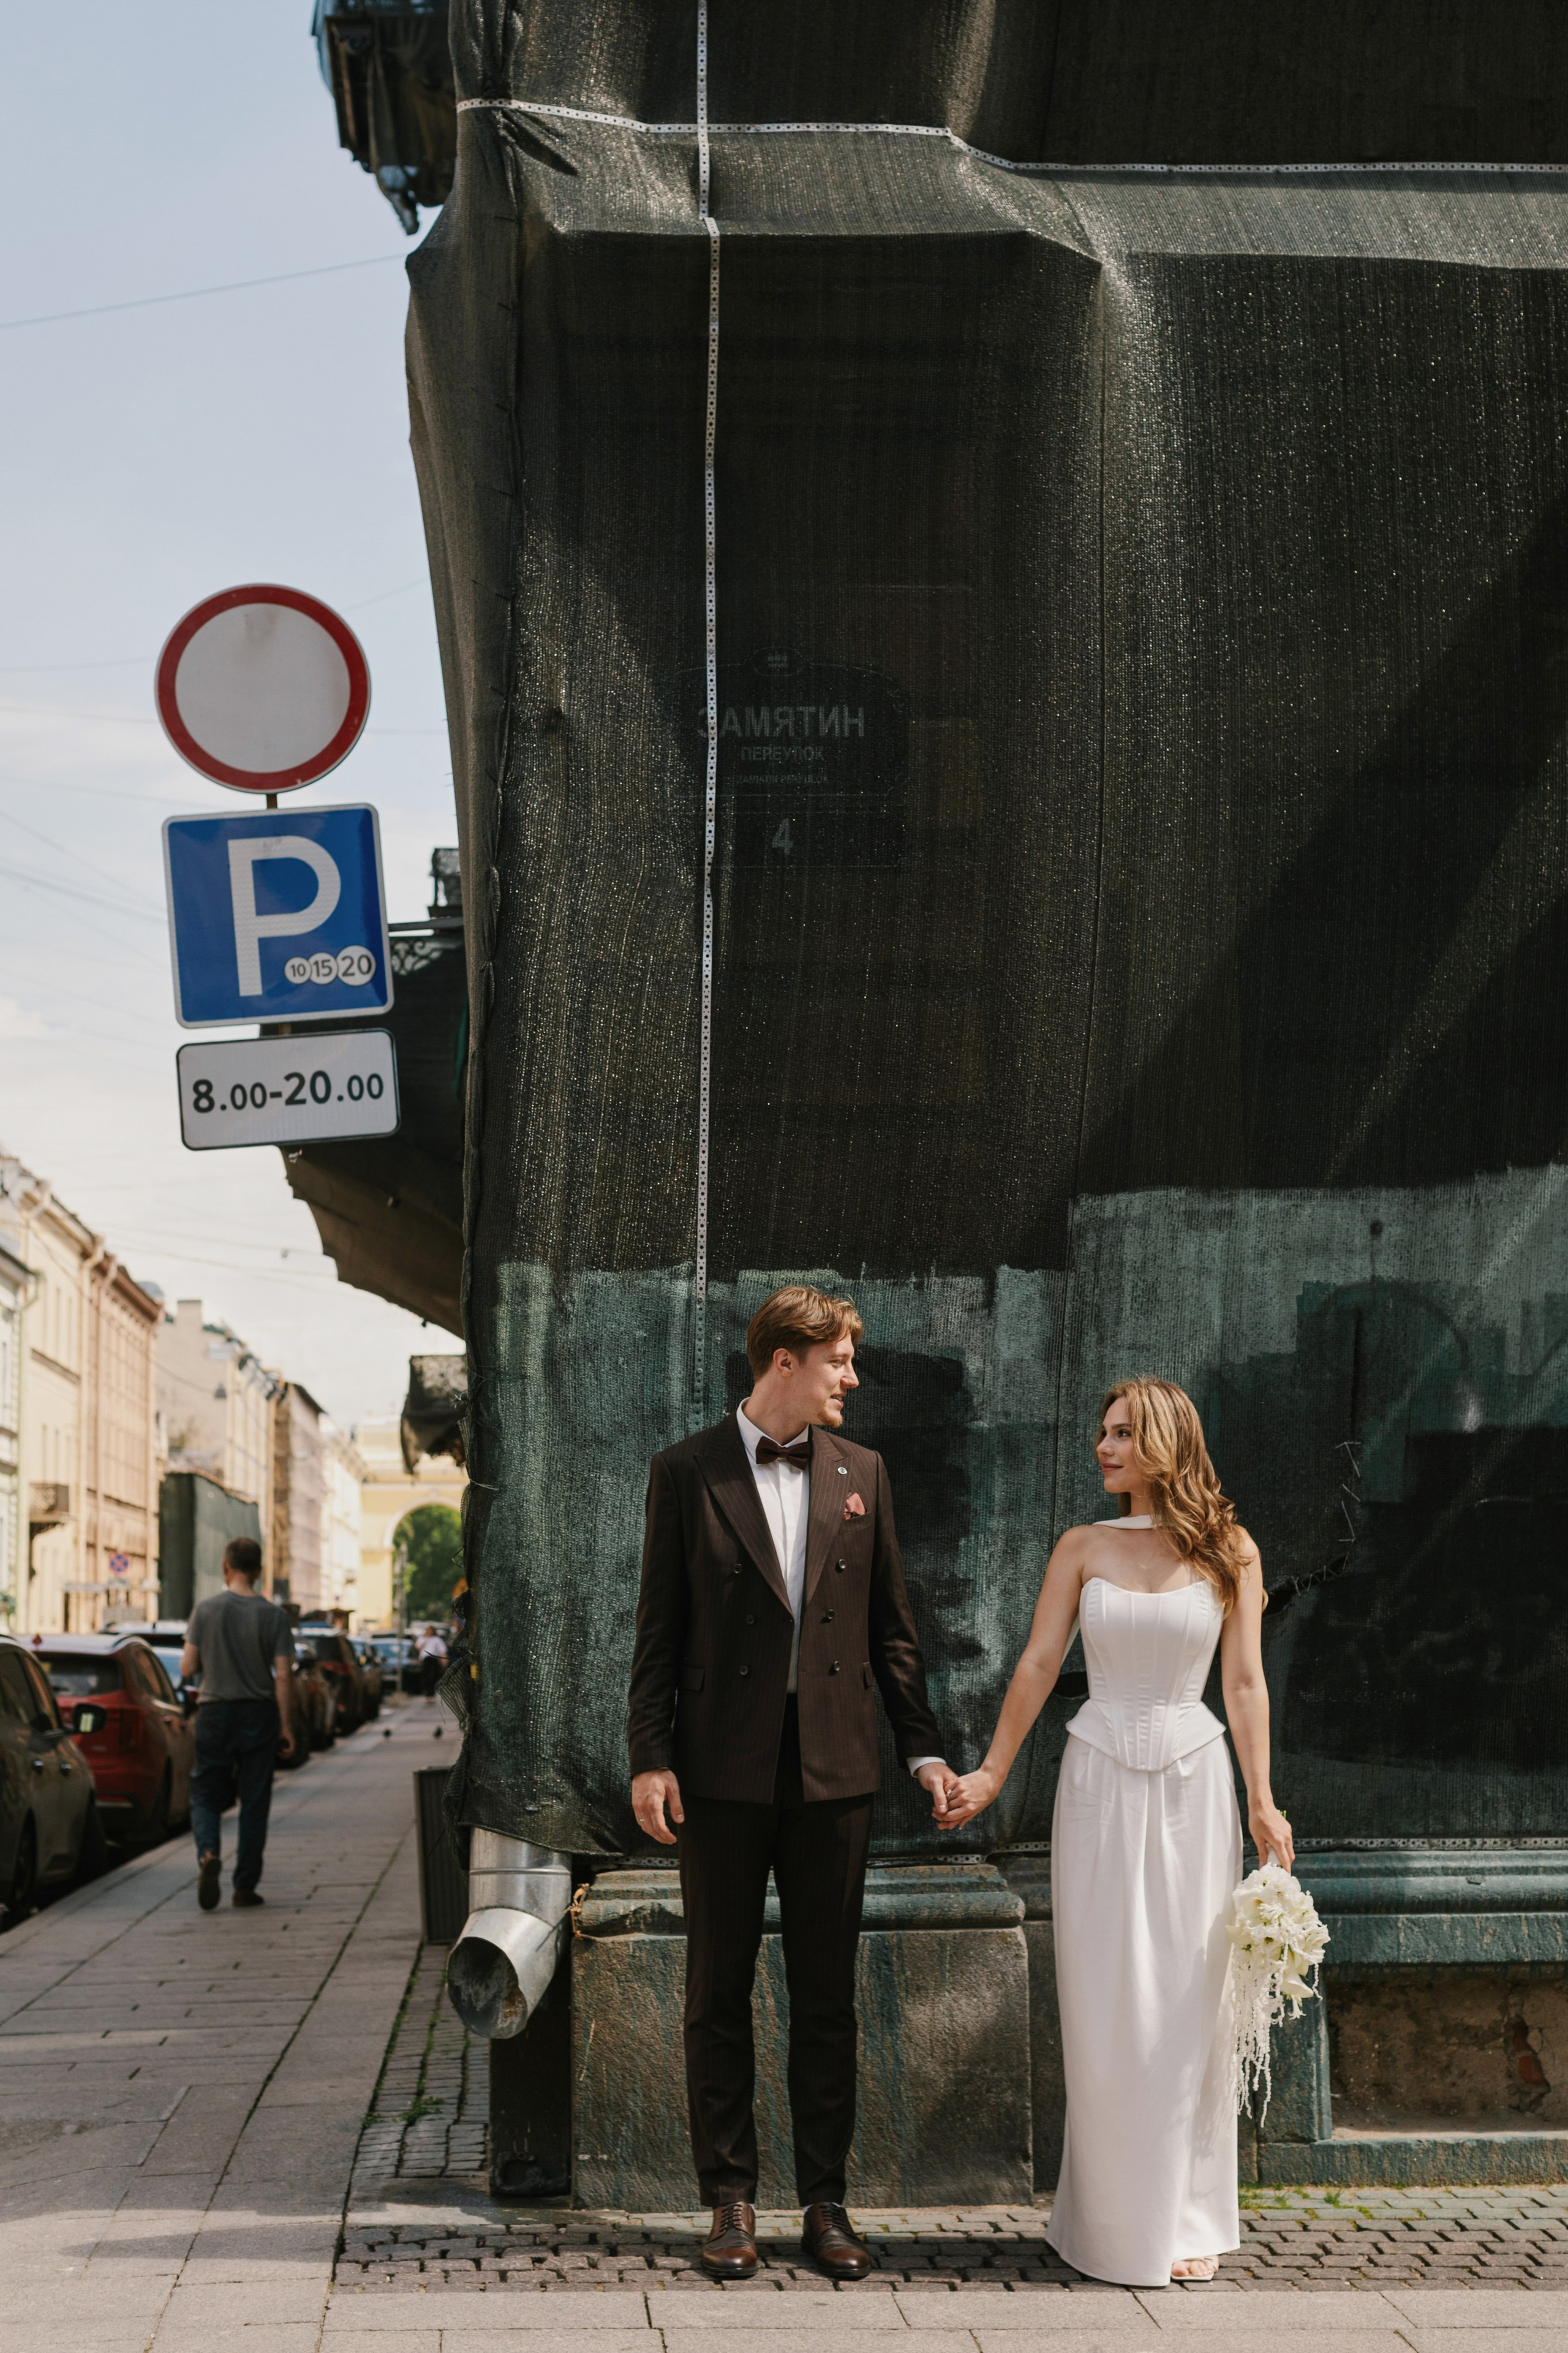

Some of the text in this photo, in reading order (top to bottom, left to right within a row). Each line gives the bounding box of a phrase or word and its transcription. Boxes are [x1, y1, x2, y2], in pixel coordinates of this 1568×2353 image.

[772, 818, 794, 855] 4
[227, 835, 342, 997] P
[290, 954, 372, 978] 10 15 20
[192, 1070, 384, 1114] 8.00-20.00
